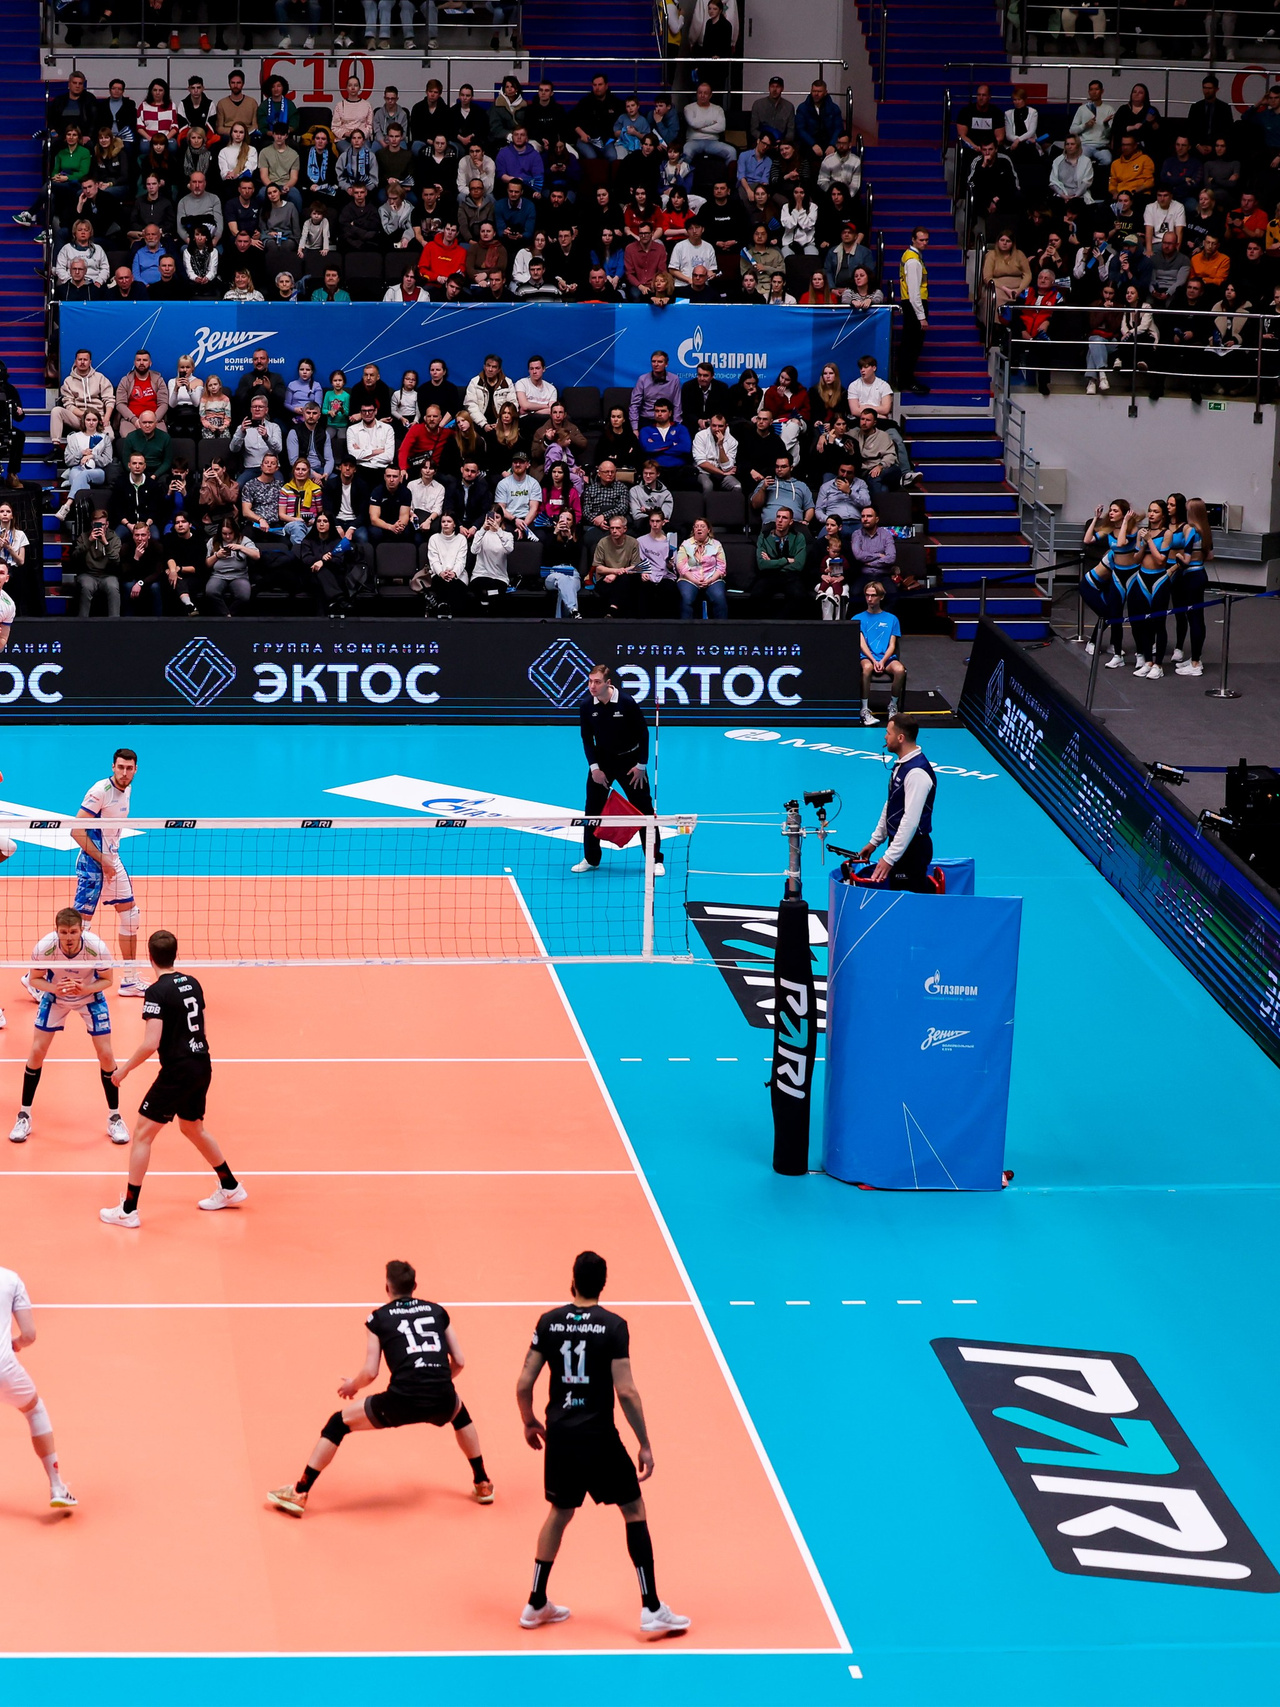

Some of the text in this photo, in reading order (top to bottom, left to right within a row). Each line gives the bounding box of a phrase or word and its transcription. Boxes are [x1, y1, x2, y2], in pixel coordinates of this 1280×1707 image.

[253, 641, 439, 653] ГРУППА КОМПАНИЙ
[616, 644, 802, 656] ГРУППА КОМПАНИЙ
[252, 662, 441, 704] ЭКТОС
[615, 665, 803, 706] ЭКТОС
[998, 697, 1044, 771] ЭКТОС
[779, 738, 1000, 780] МЕГАОН
[573, 819, 601, 827] PARI
[703, 906, 829, 1029] PA
[940, 985, 978, 996] ГАЗПРОМ
[183, 996, 200, 1032] 2
[777, 977, 809, 1099] PARI
[142, 1101, 149, 1111] 2
[397, 1316, 441, 1355] 15
[559, 1340, 590, 1384] 11
[957, 1346, 1252, 1580] PARI
